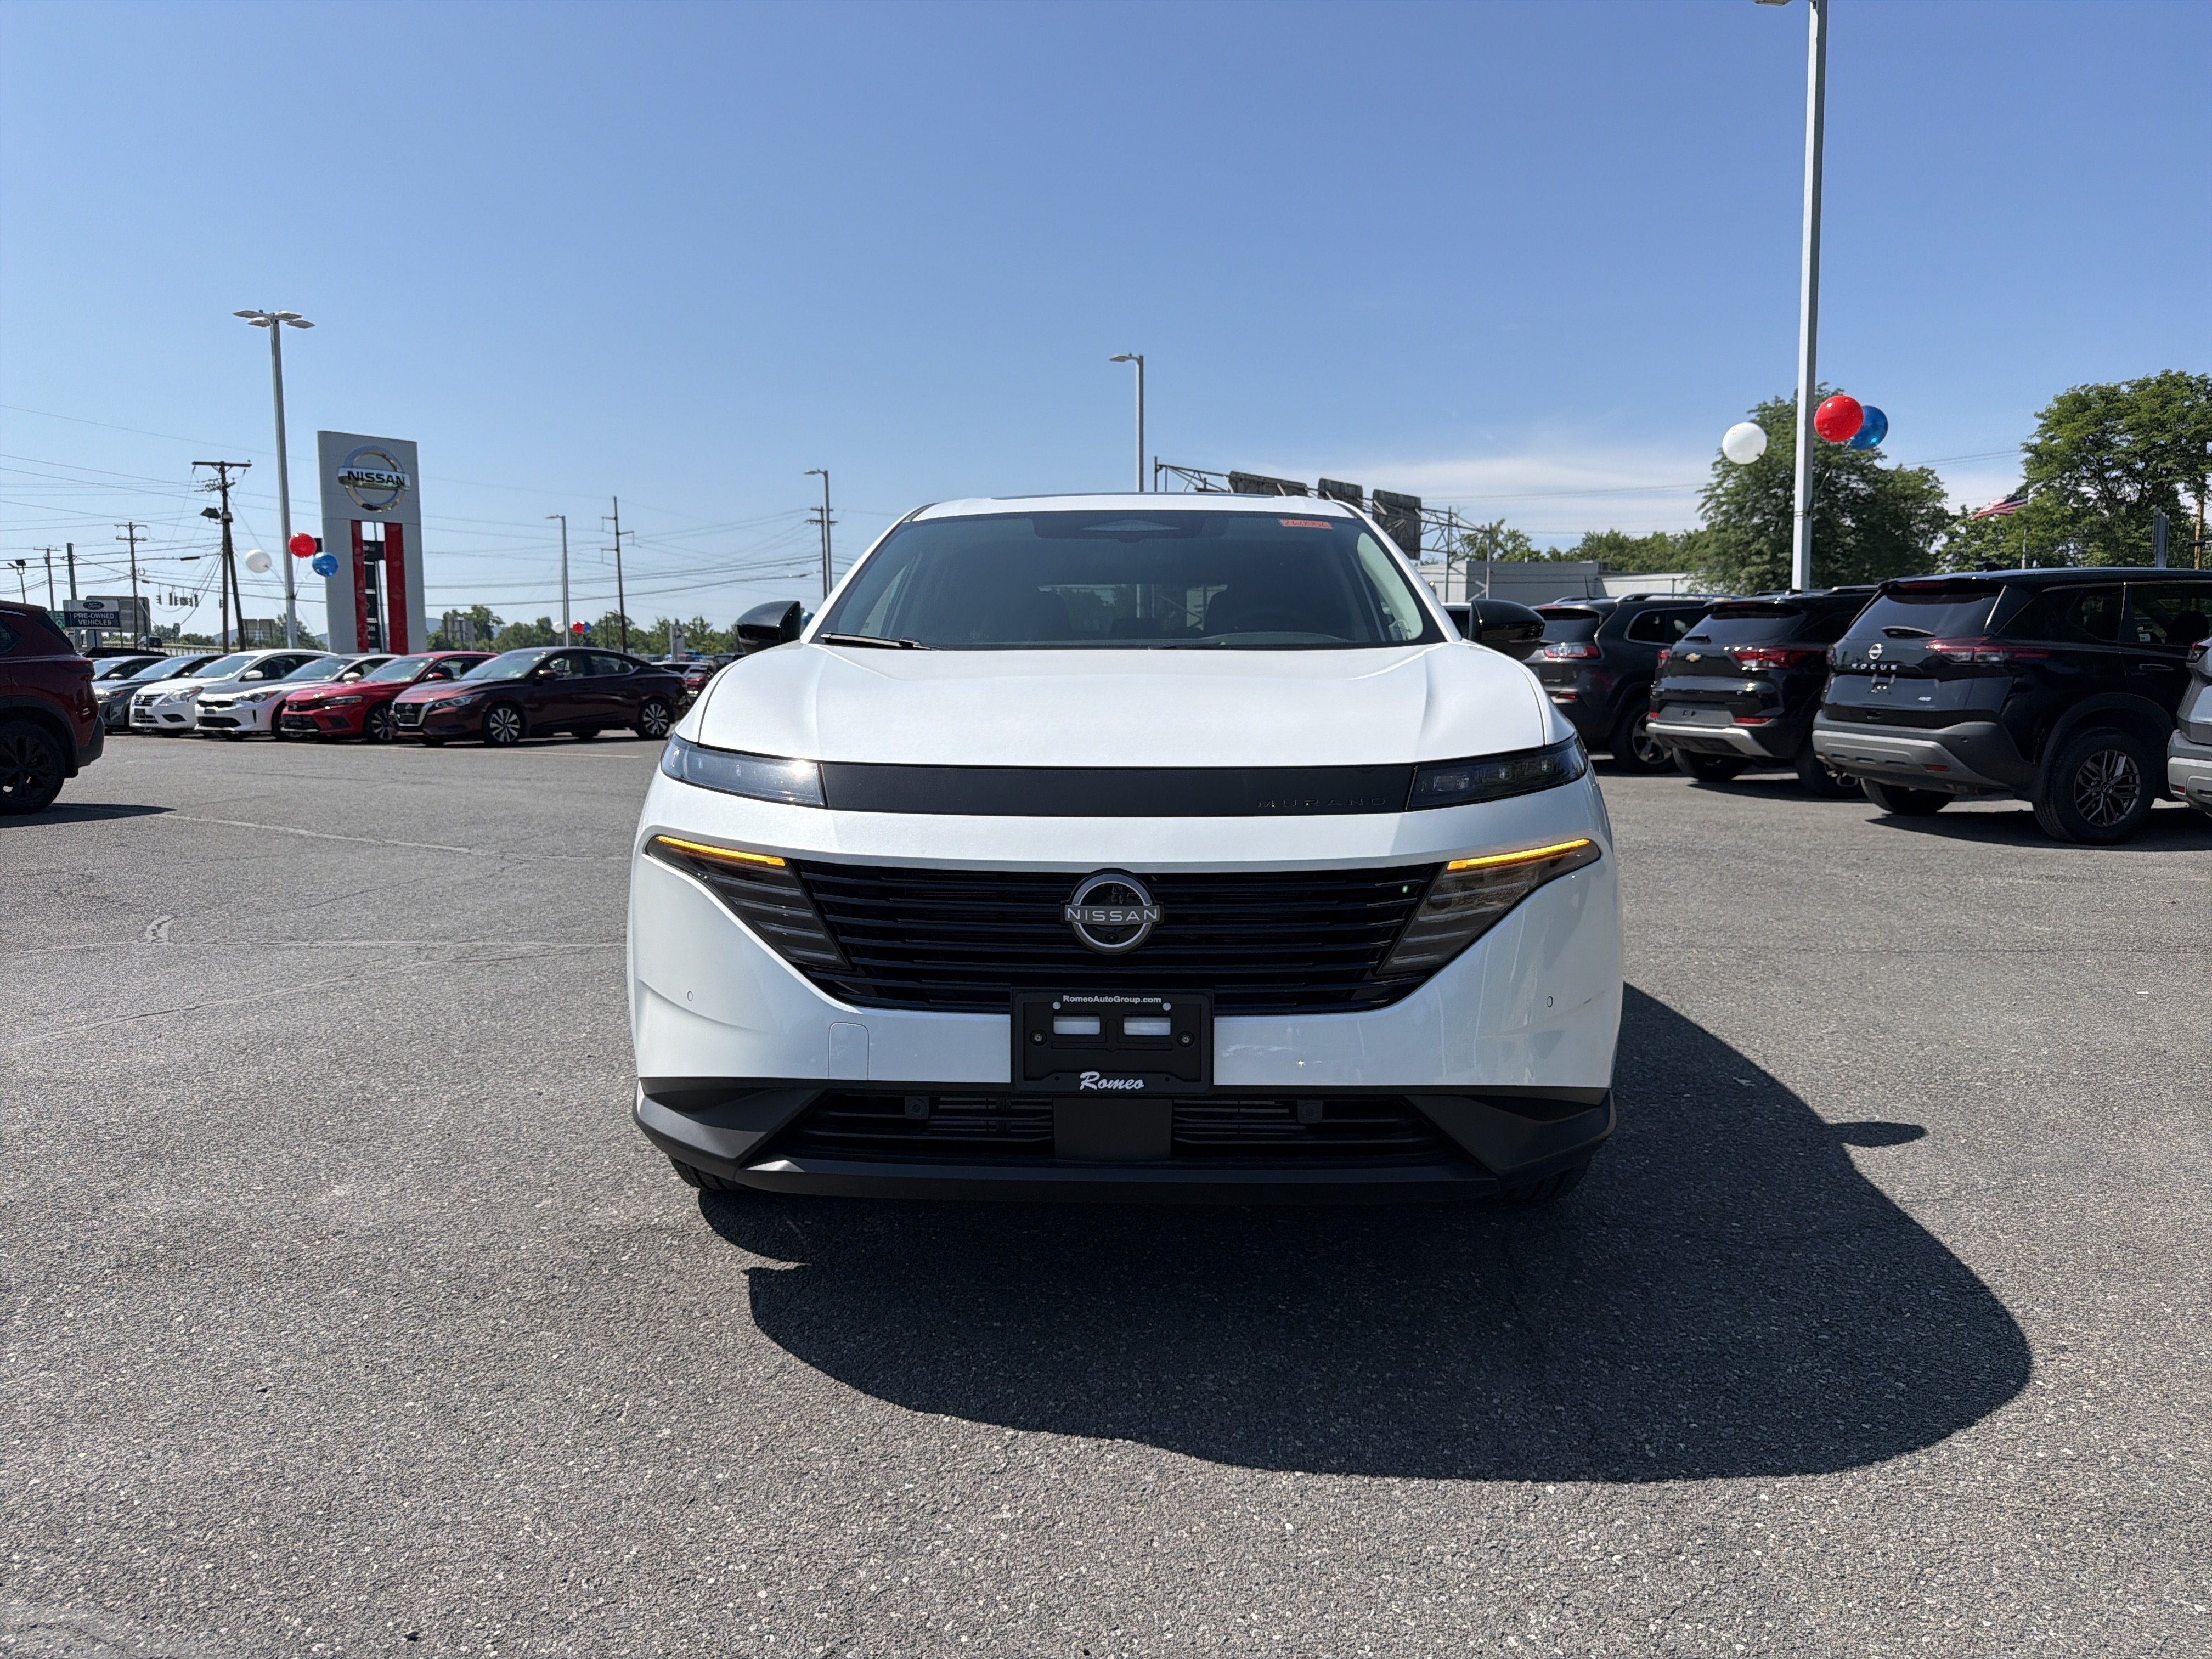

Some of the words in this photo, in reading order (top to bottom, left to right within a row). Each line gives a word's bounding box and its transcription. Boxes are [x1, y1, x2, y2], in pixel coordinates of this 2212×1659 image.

[347, 470, 405, 487] NISSAN
[1257, 797, 1385, 808] MURANO
[1067, 908, 1157, 922] NISSAN
[1063, 995, 1161, 1005] RomeoAutoGroup.com
[1079, 1071, 1145, 1090] Romeo
